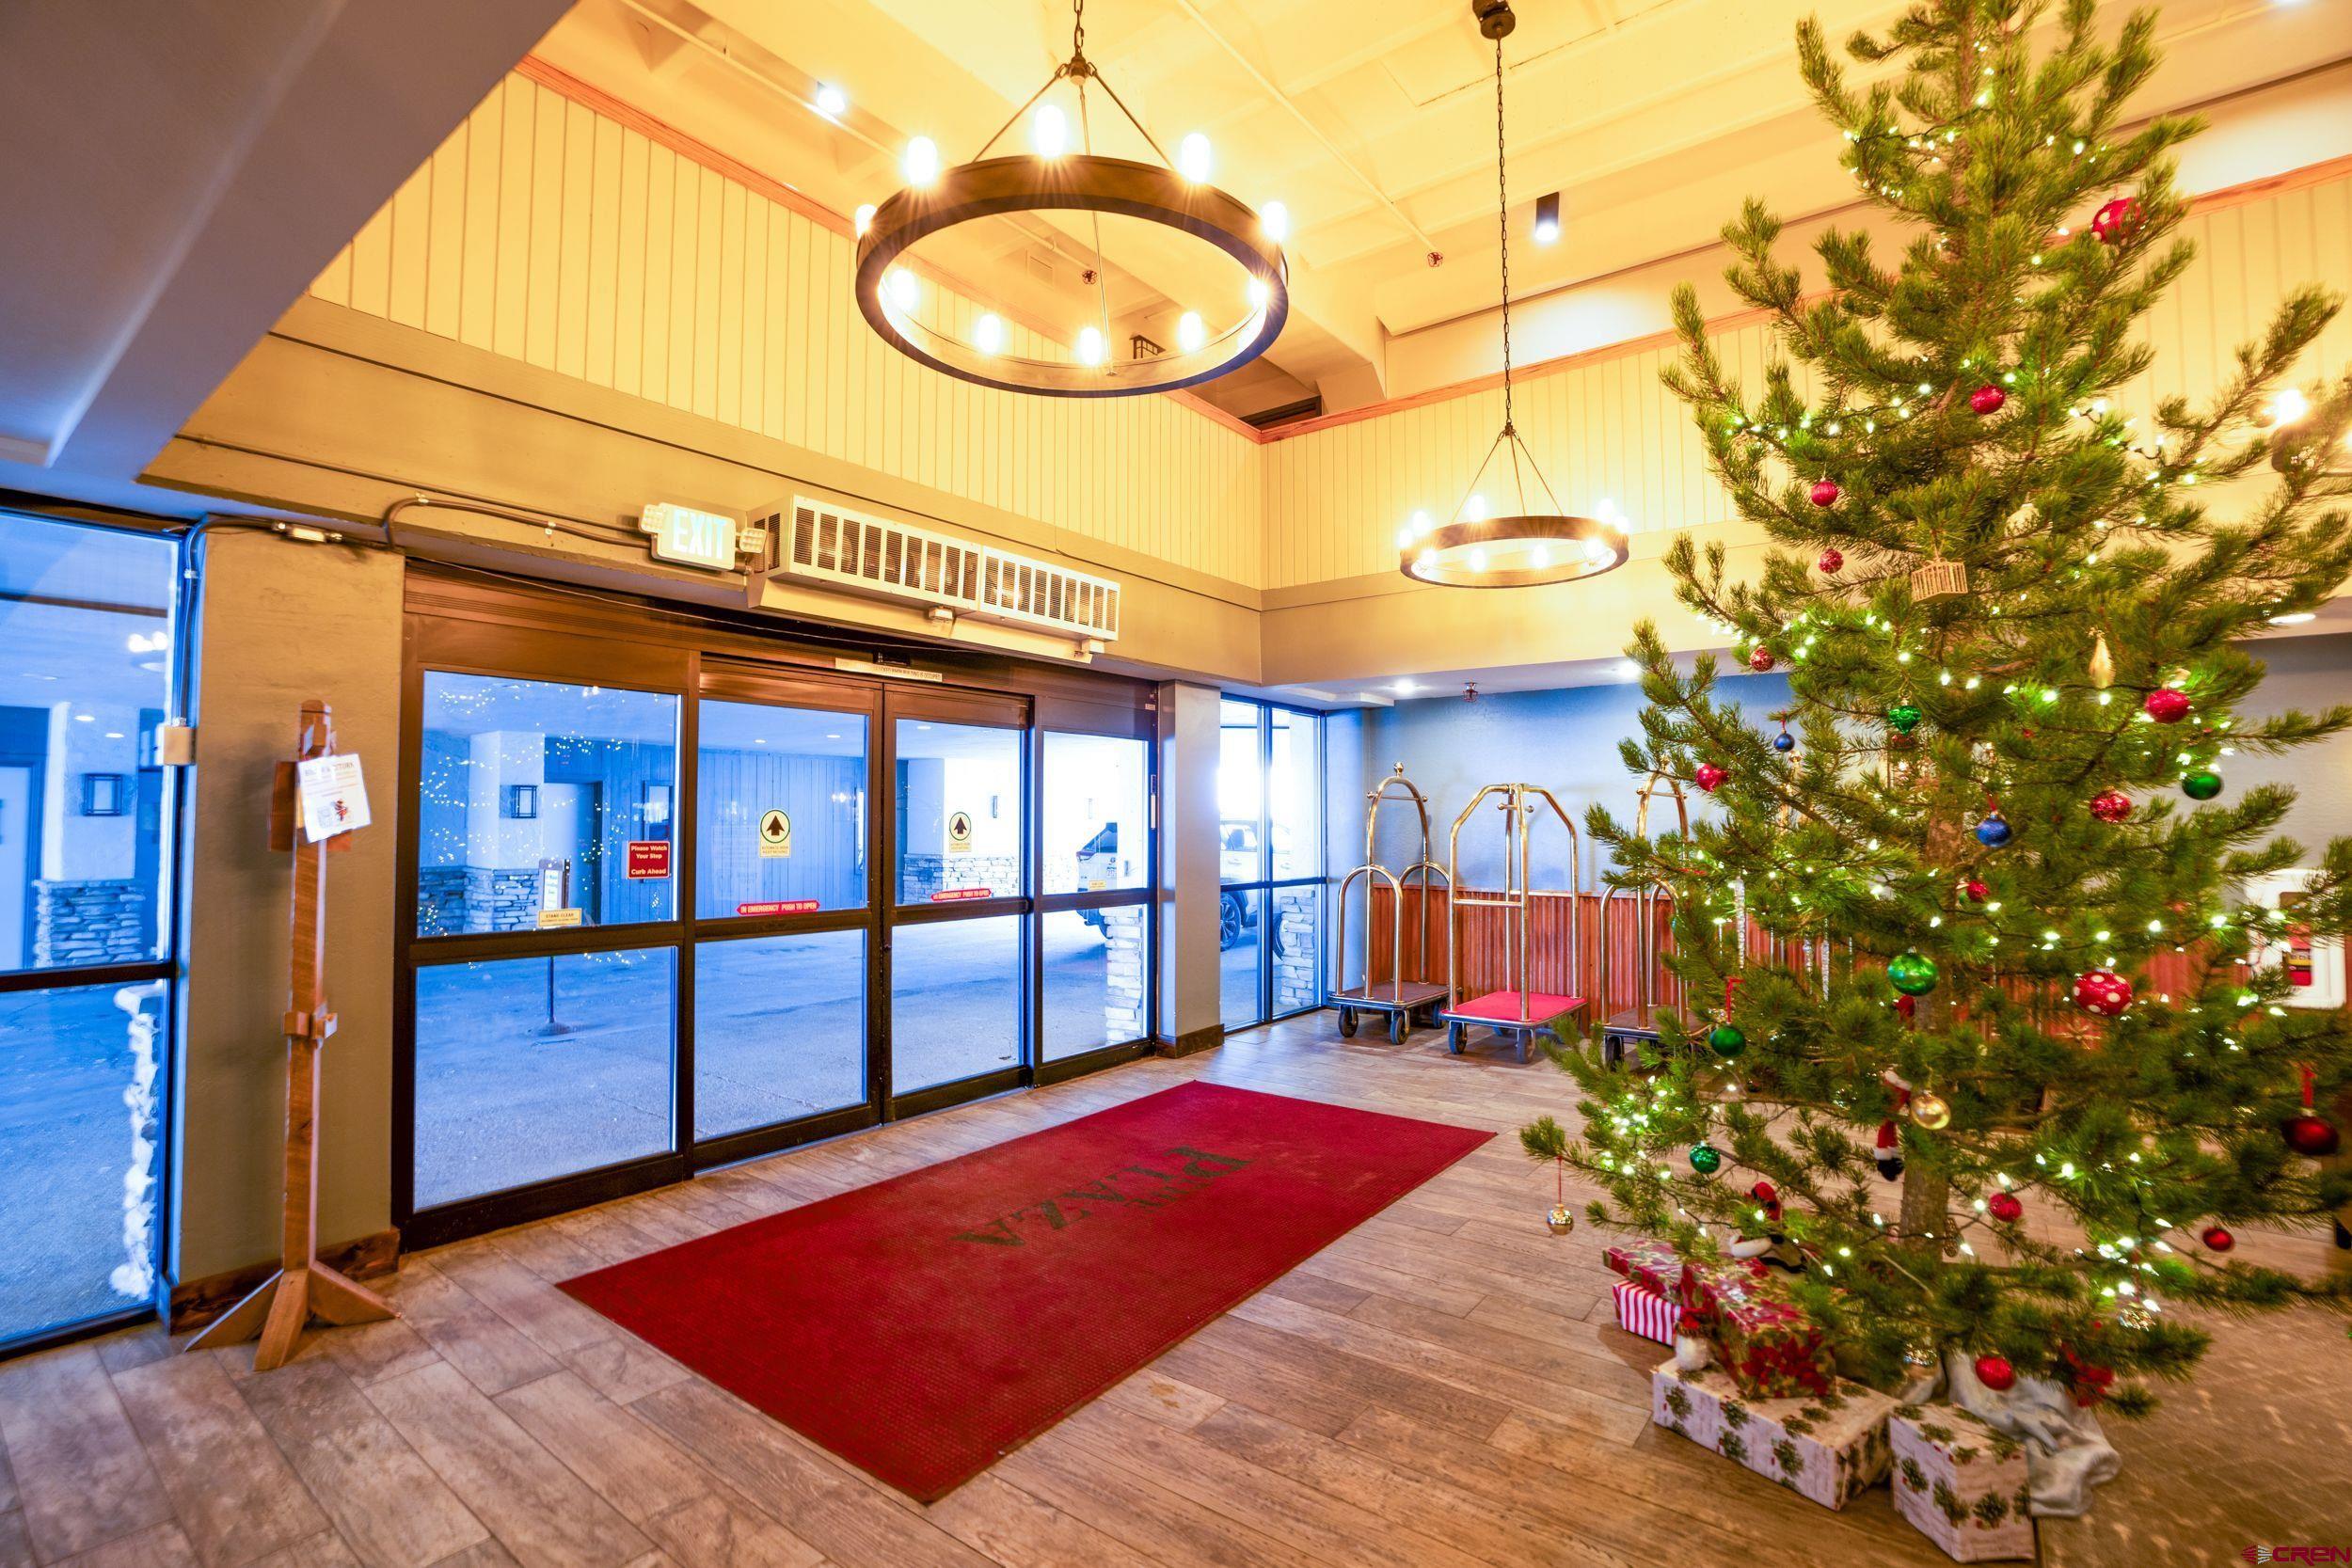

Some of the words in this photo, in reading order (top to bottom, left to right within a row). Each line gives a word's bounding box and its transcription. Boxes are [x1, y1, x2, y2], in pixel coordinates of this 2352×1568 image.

[672, 509, 727, 560] EXIT
[748, 905, 779, 913] EMERGENCY
[782, 903, 796, 911] PUSH
[947, 1145, 1255, 1247] PLAZA
